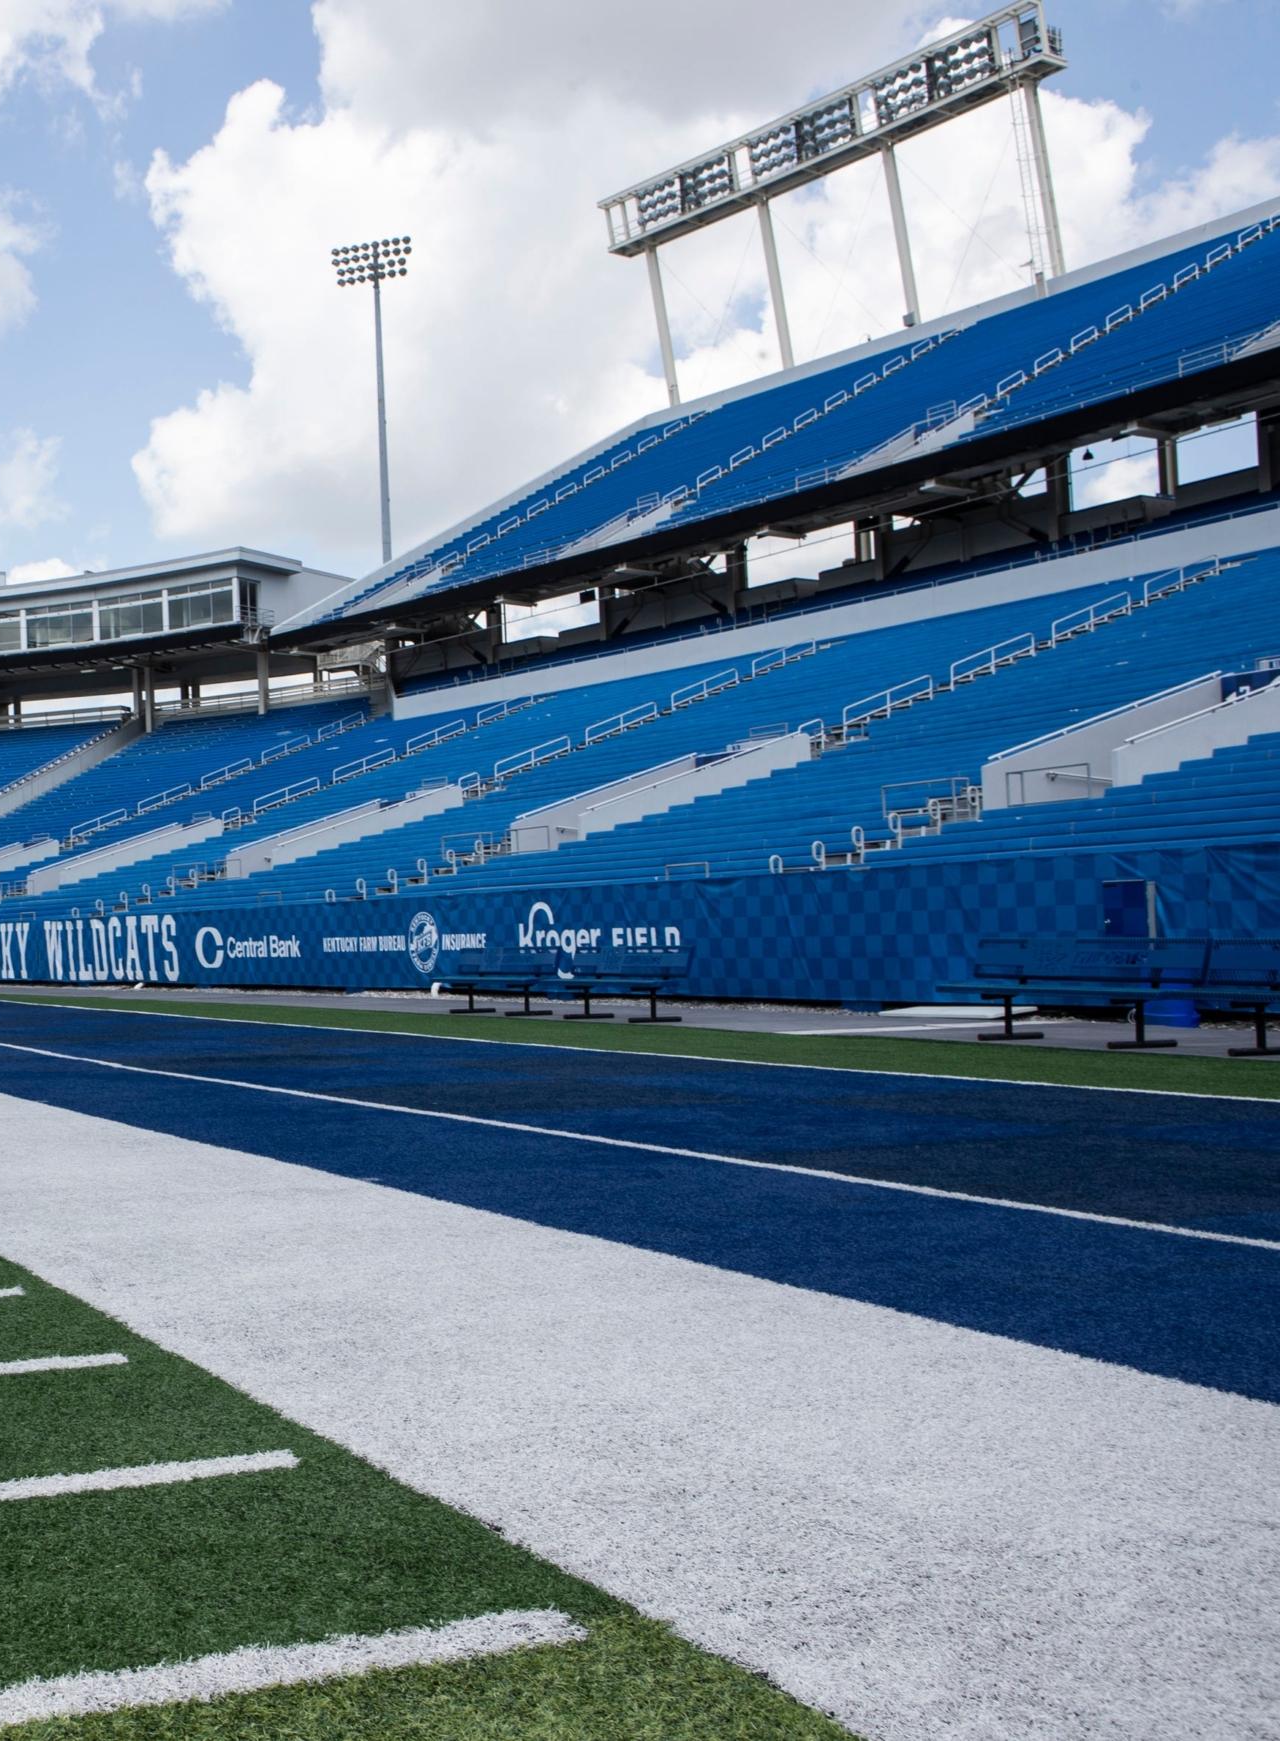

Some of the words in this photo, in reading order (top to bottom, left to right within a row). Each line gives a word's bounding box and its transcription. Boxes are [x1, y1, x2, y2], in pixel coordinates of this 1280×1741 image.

[43, 914, 180, 981] WILDCATS
[227, 936, 268, 958] Central
[269, 934, 301, 958] Bank
[323, 937, 358, 952] KENTUCKY
[359, 936, 378, 952] FARM
[379, 935, 406, 951] BUREAU
[442, 933, 487, 951] INSURANCE
[518, 901, 602, 979] Kroger
[612, 926, 681, 953] FIELD
